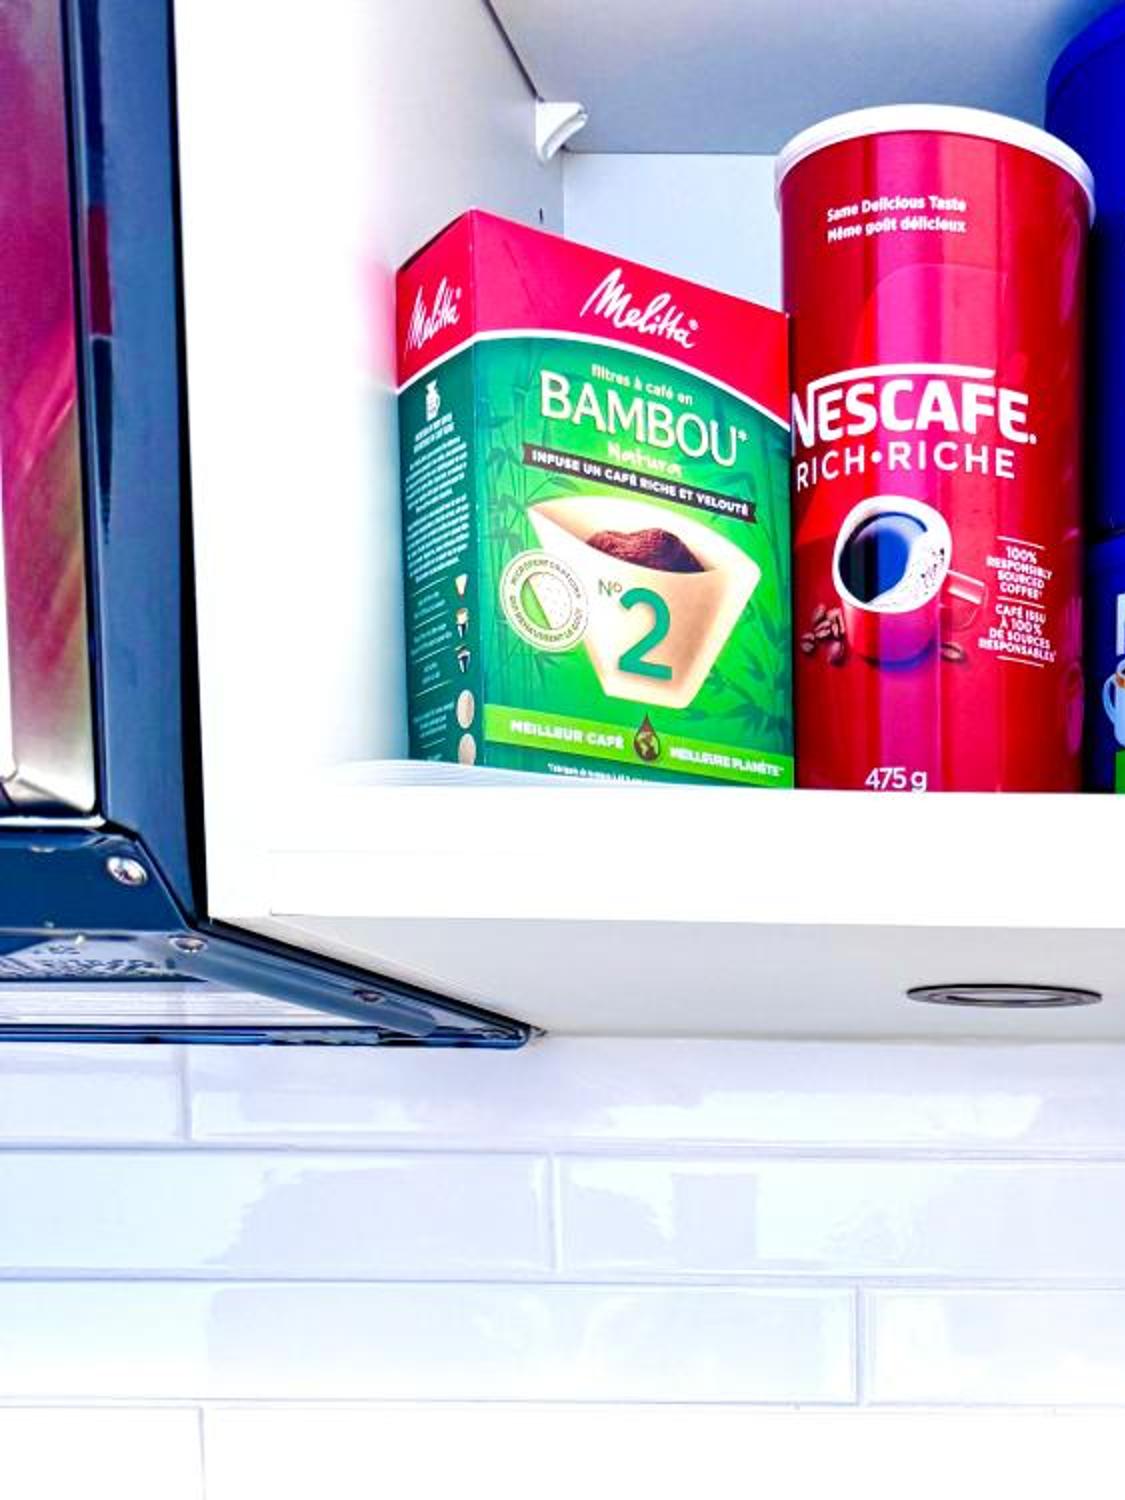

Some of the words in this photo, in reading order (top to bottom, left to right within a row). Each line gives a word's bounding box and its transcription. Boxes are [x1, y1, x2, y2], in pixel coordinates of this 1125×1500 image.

[827, 204, 858, 223] Same
[862, 196, 925, 213] Delicious
[928, 195, 967, 213] Taste
[827, 222, 862, 244] Même
[865, 217, 897, 236] goût
[900, 216, 967, 233] délicieux
[591, 363, 630, 387] filtres
[634, 375, 644, 391] à
[646, 382, 674, 400] café
[677, 392, 693, 405] en
[532, 449, 580, 472] INFUSE
[583, 462, 601, 477] UN
[604, 467, 638, 487] CAFÉ
[639, 476, 677, 497] RICHE
[679, 485, 694, 502] ET
[696, 492, 749, 516] VELOUTÉ
[1006, 545, 1037, 564] 100%
[985, 555, 1053, 580] RESPONSIBLY
[997, 570, 1045, 589] SOURCED
[995, 603, 1023, 619] CAFÉ
[618, 588, 673, 681] 2
[988, 627, 1005, 640] DE
[1007, 630, 1051, 650] SOURCES
[510, 719, 583, 744] MEILLEUR
[865, 767, 907, 789] 475
[911, 770, 928, 793] g
